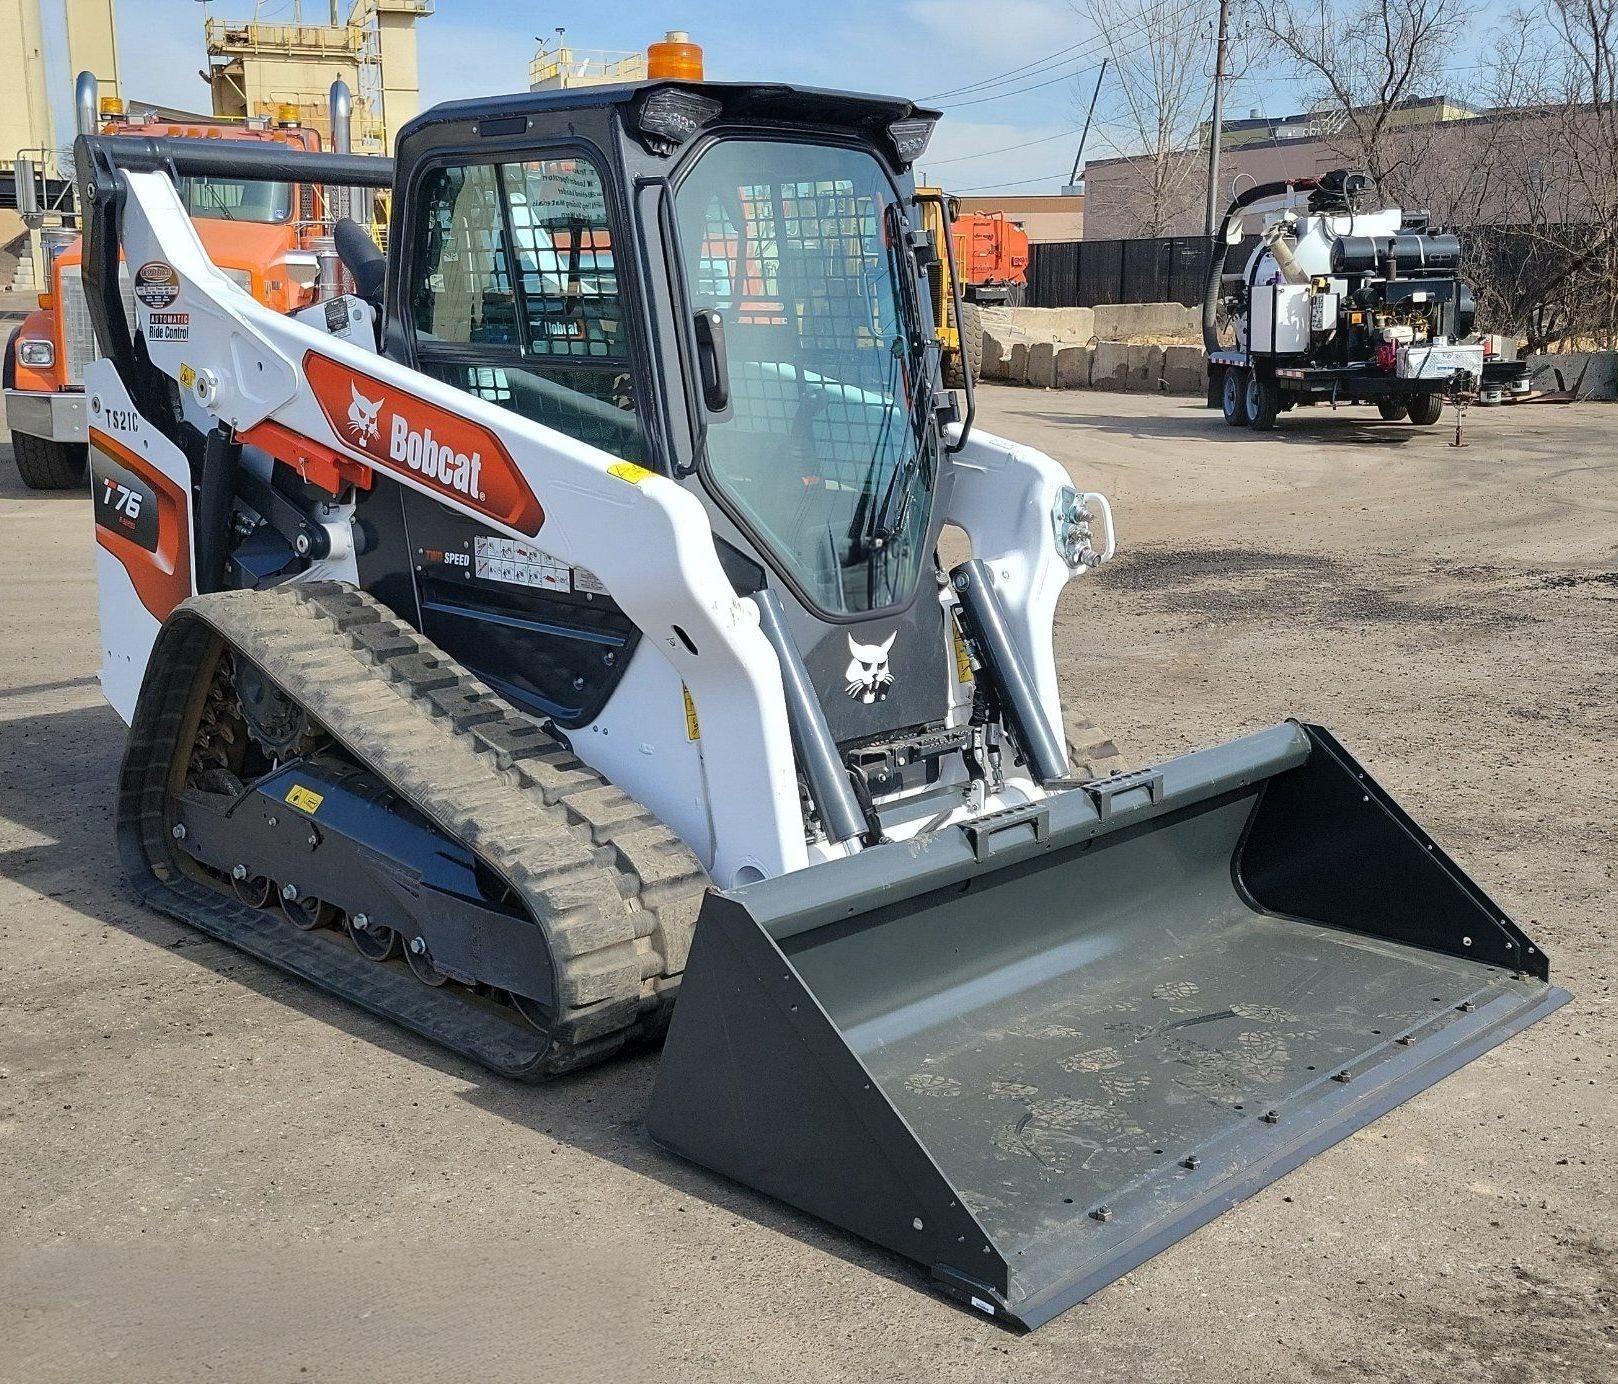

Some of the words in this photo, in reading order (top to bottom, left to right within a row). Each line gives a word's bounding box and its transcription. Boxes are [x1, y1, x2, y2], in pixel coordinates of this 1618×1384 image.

[151, 315, 188, 324] AUTOMATIC
[149, 326, 164, 339] Ride
[165, 326, 189, 340] Control
[389, 413, 481, 499] Bobcat
[444, 552, 470, 567] SPEED
